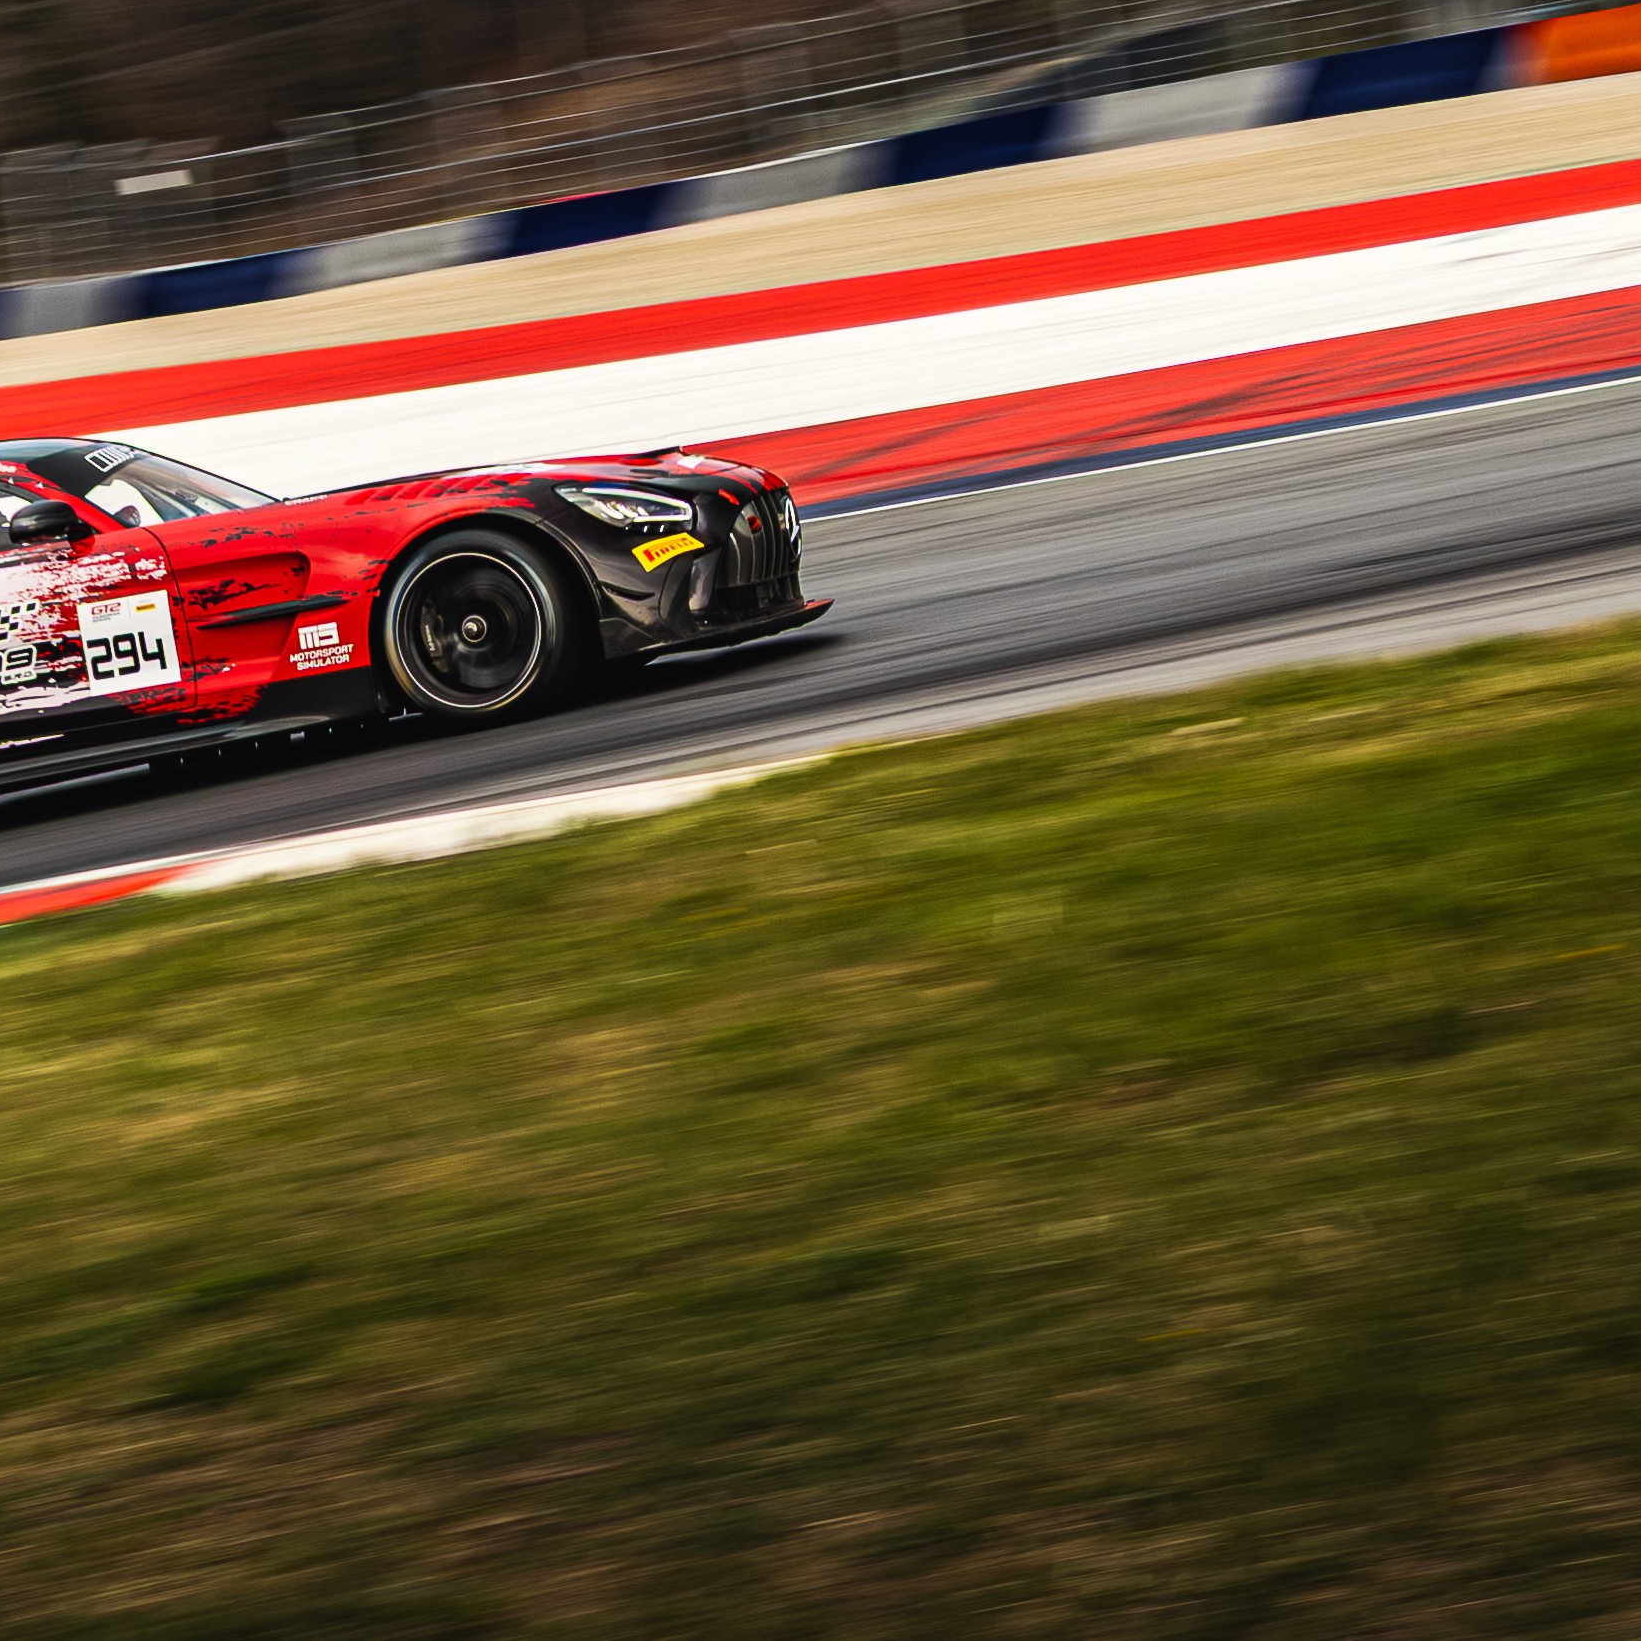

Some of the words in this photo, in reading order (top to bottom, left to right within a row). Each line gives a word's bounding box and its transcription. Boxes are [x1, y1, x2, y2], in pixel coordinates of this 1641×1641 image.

[86, 631, 168, 681] 294
[289, 643, 354, 663] MOTORSPORT
[297, 653, 350, 671] SIMULATOR
